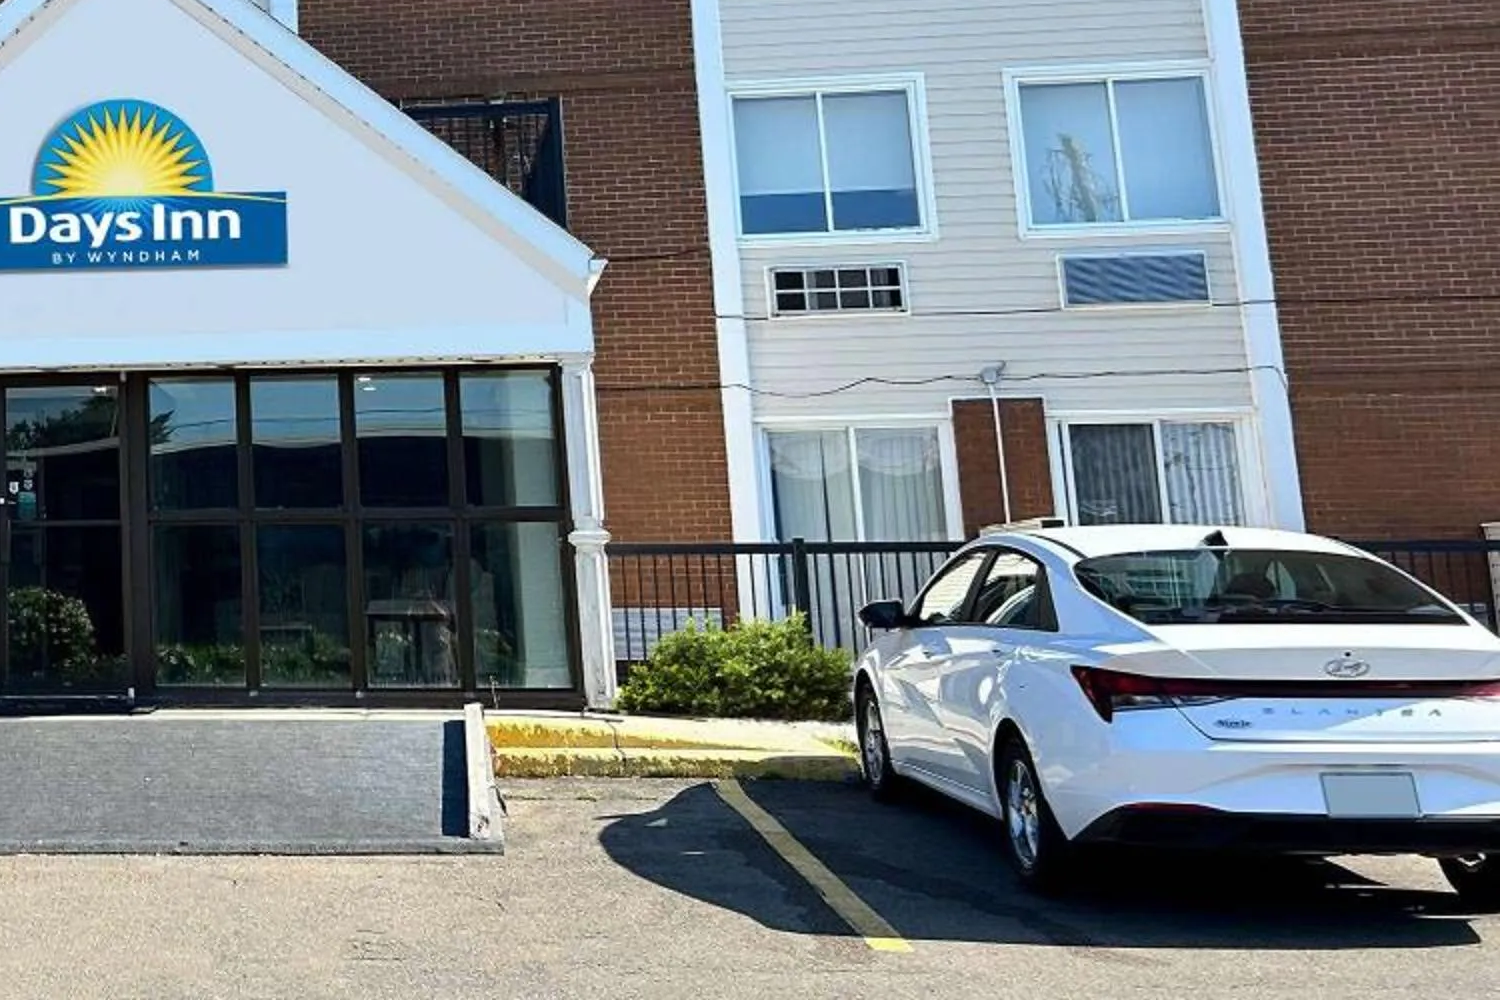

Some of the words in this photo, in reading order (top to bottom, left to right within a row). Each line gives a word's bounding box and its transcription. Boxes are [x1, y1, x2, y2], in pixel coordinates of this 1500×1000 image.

[9, 205, 143, 249] Days
[152, 203, 242, 241] Inn
[52, 251, 77, 265] BY
[86, 249, 201, 264] WYNDHAM
[1262, 706, 1443, 717] ELANTRA
